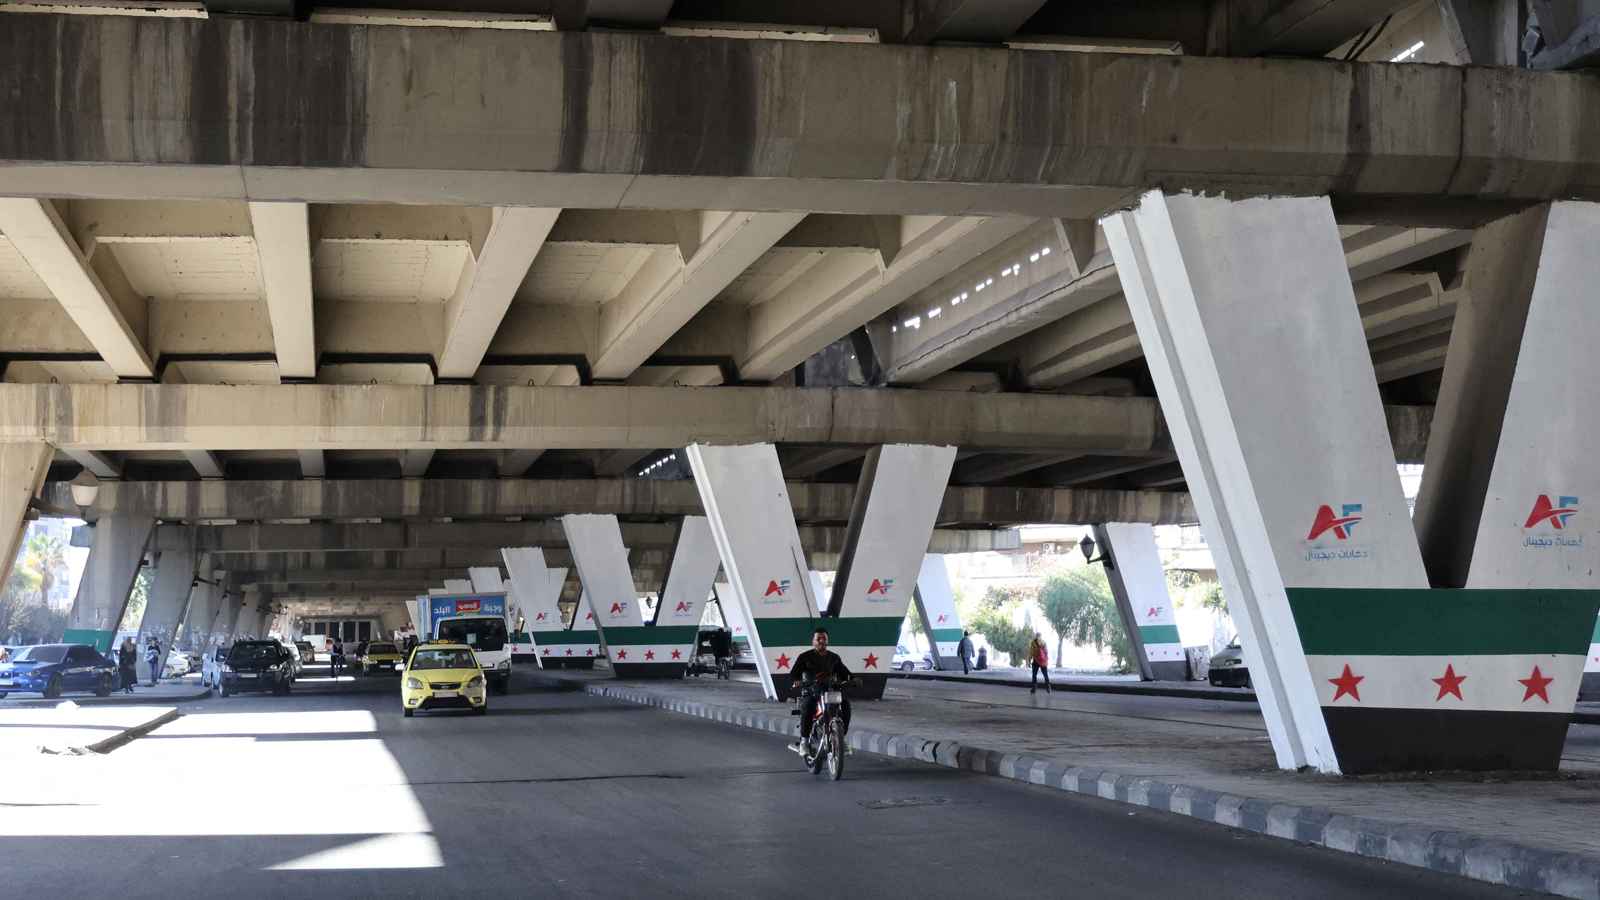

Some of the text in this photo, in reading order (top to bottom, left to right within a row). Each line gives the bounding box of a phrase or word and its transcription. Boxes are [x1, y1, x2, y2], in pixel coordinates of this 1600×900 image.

[1306, 503, 1364, 541] AF
[1524, 494, 1579, 530] AF
[764, 579, 791, 596] AF
[864, 578, 894, 594] AF
